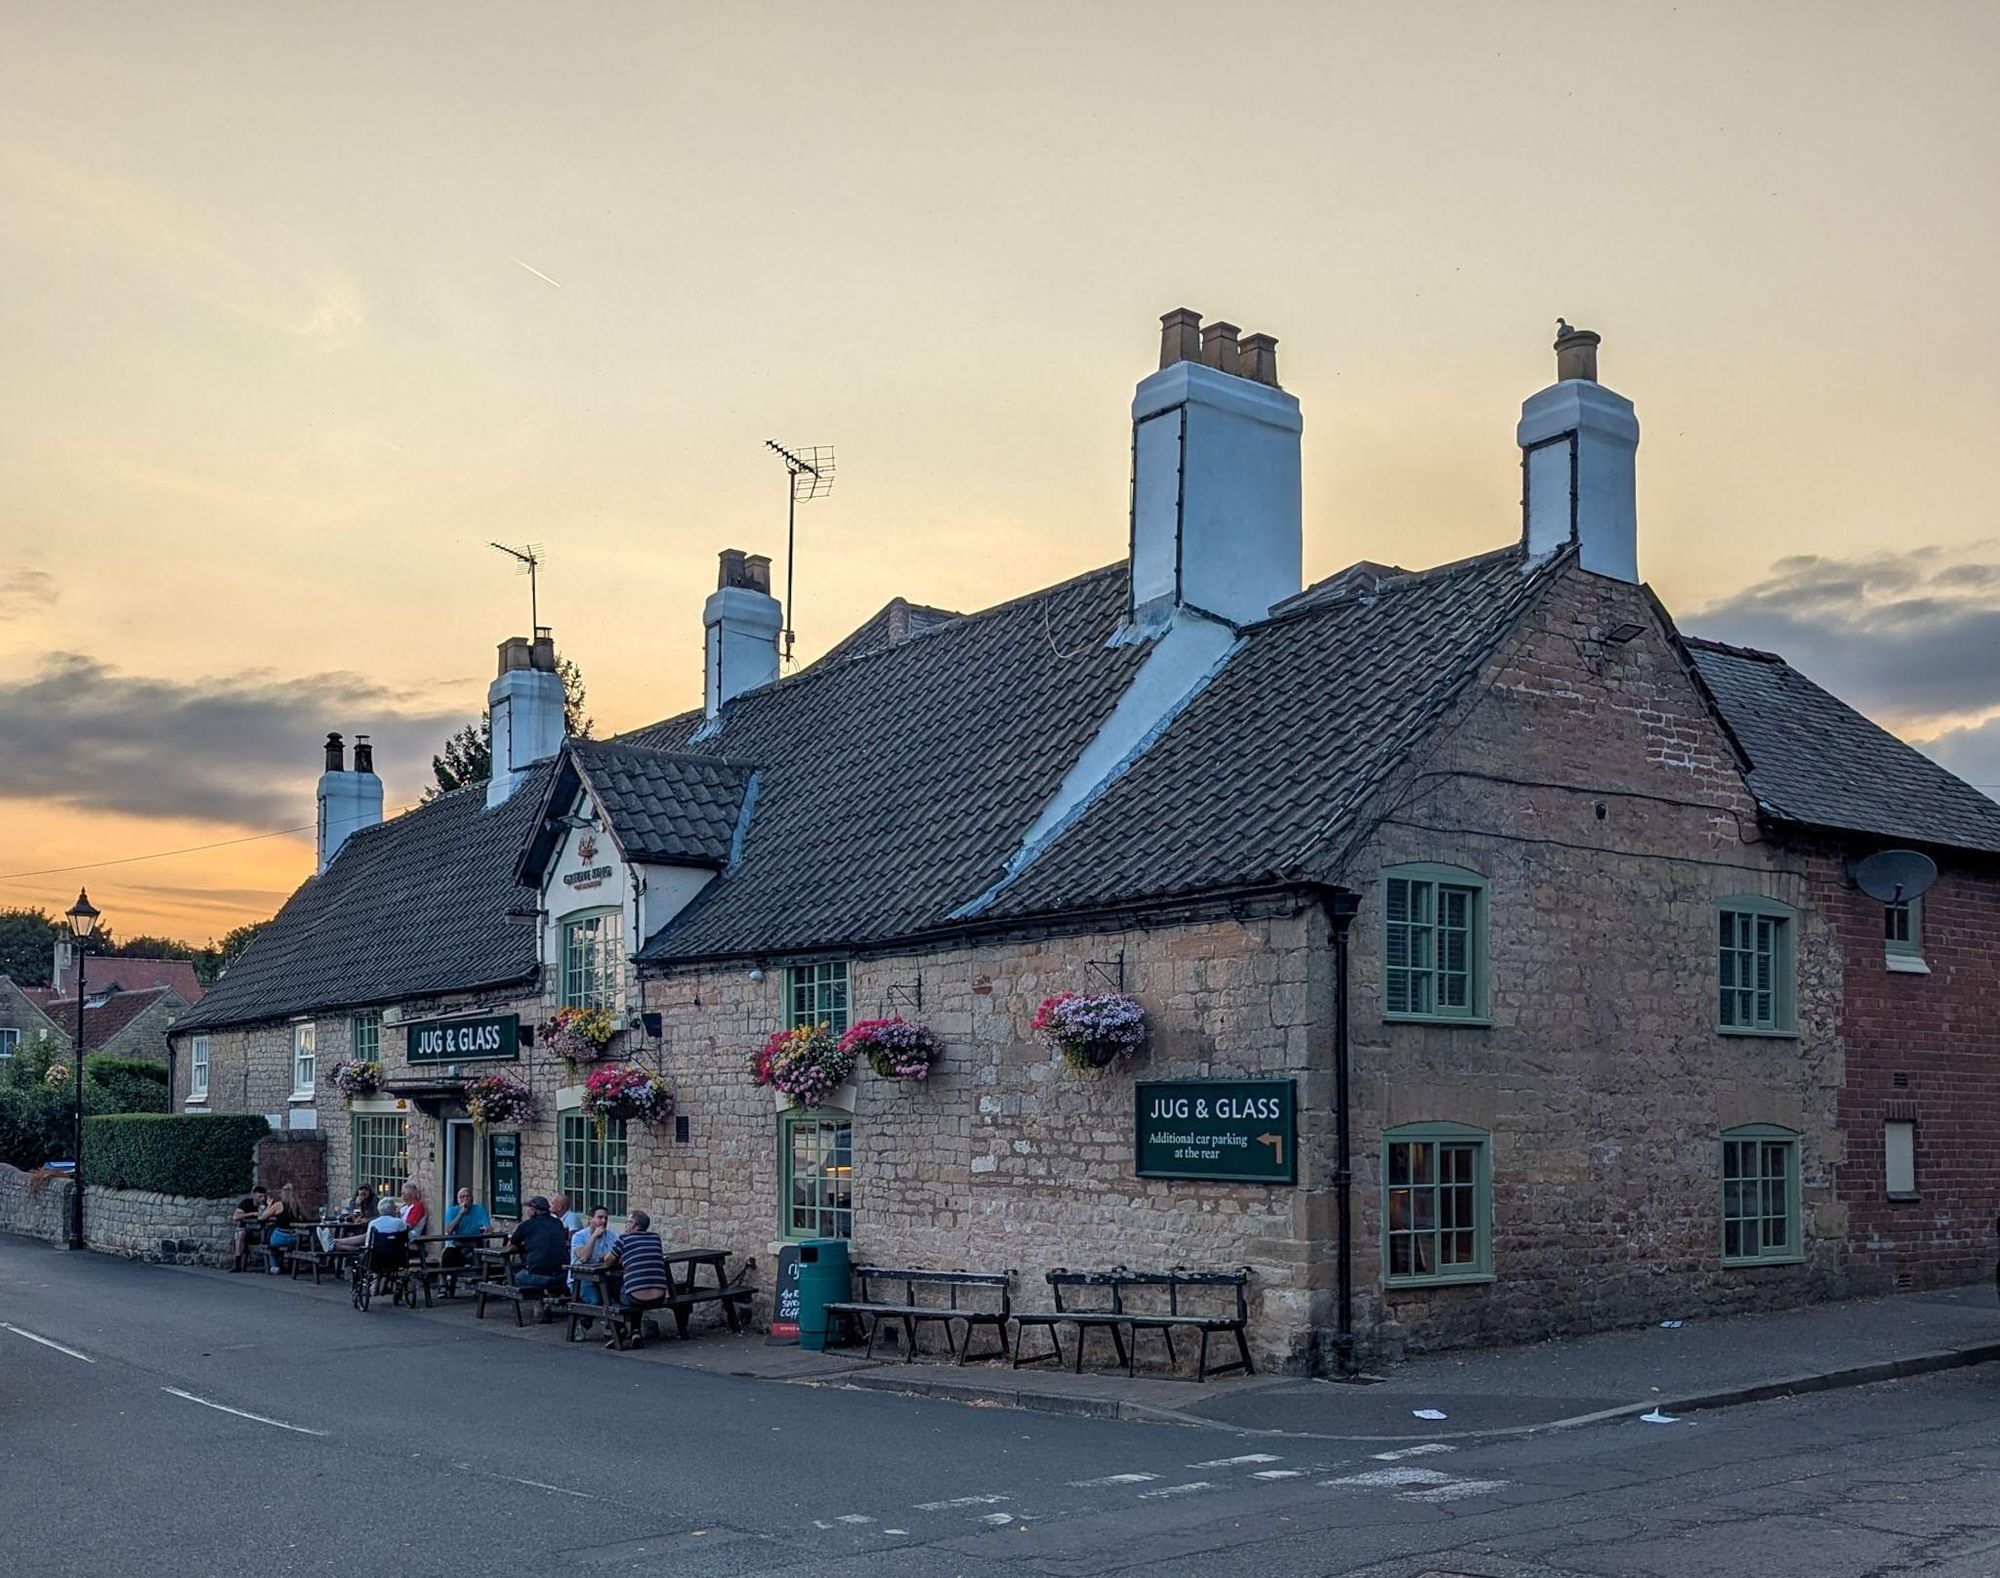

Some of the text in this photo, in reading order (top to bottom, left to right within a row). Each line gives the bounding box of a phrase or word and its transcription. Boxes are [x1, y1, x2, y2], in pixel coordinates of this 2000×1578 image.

[418, 1025, 500, 1054] JUG & GLASS
[1150, 1098, 1280, 1119] JUG & GLASS
[1149, 1131, 1248, 1148] Additional car parking
[1174, 1147, 1220, 1159] at the rear
[498, 1179, 514, 1192] Food
